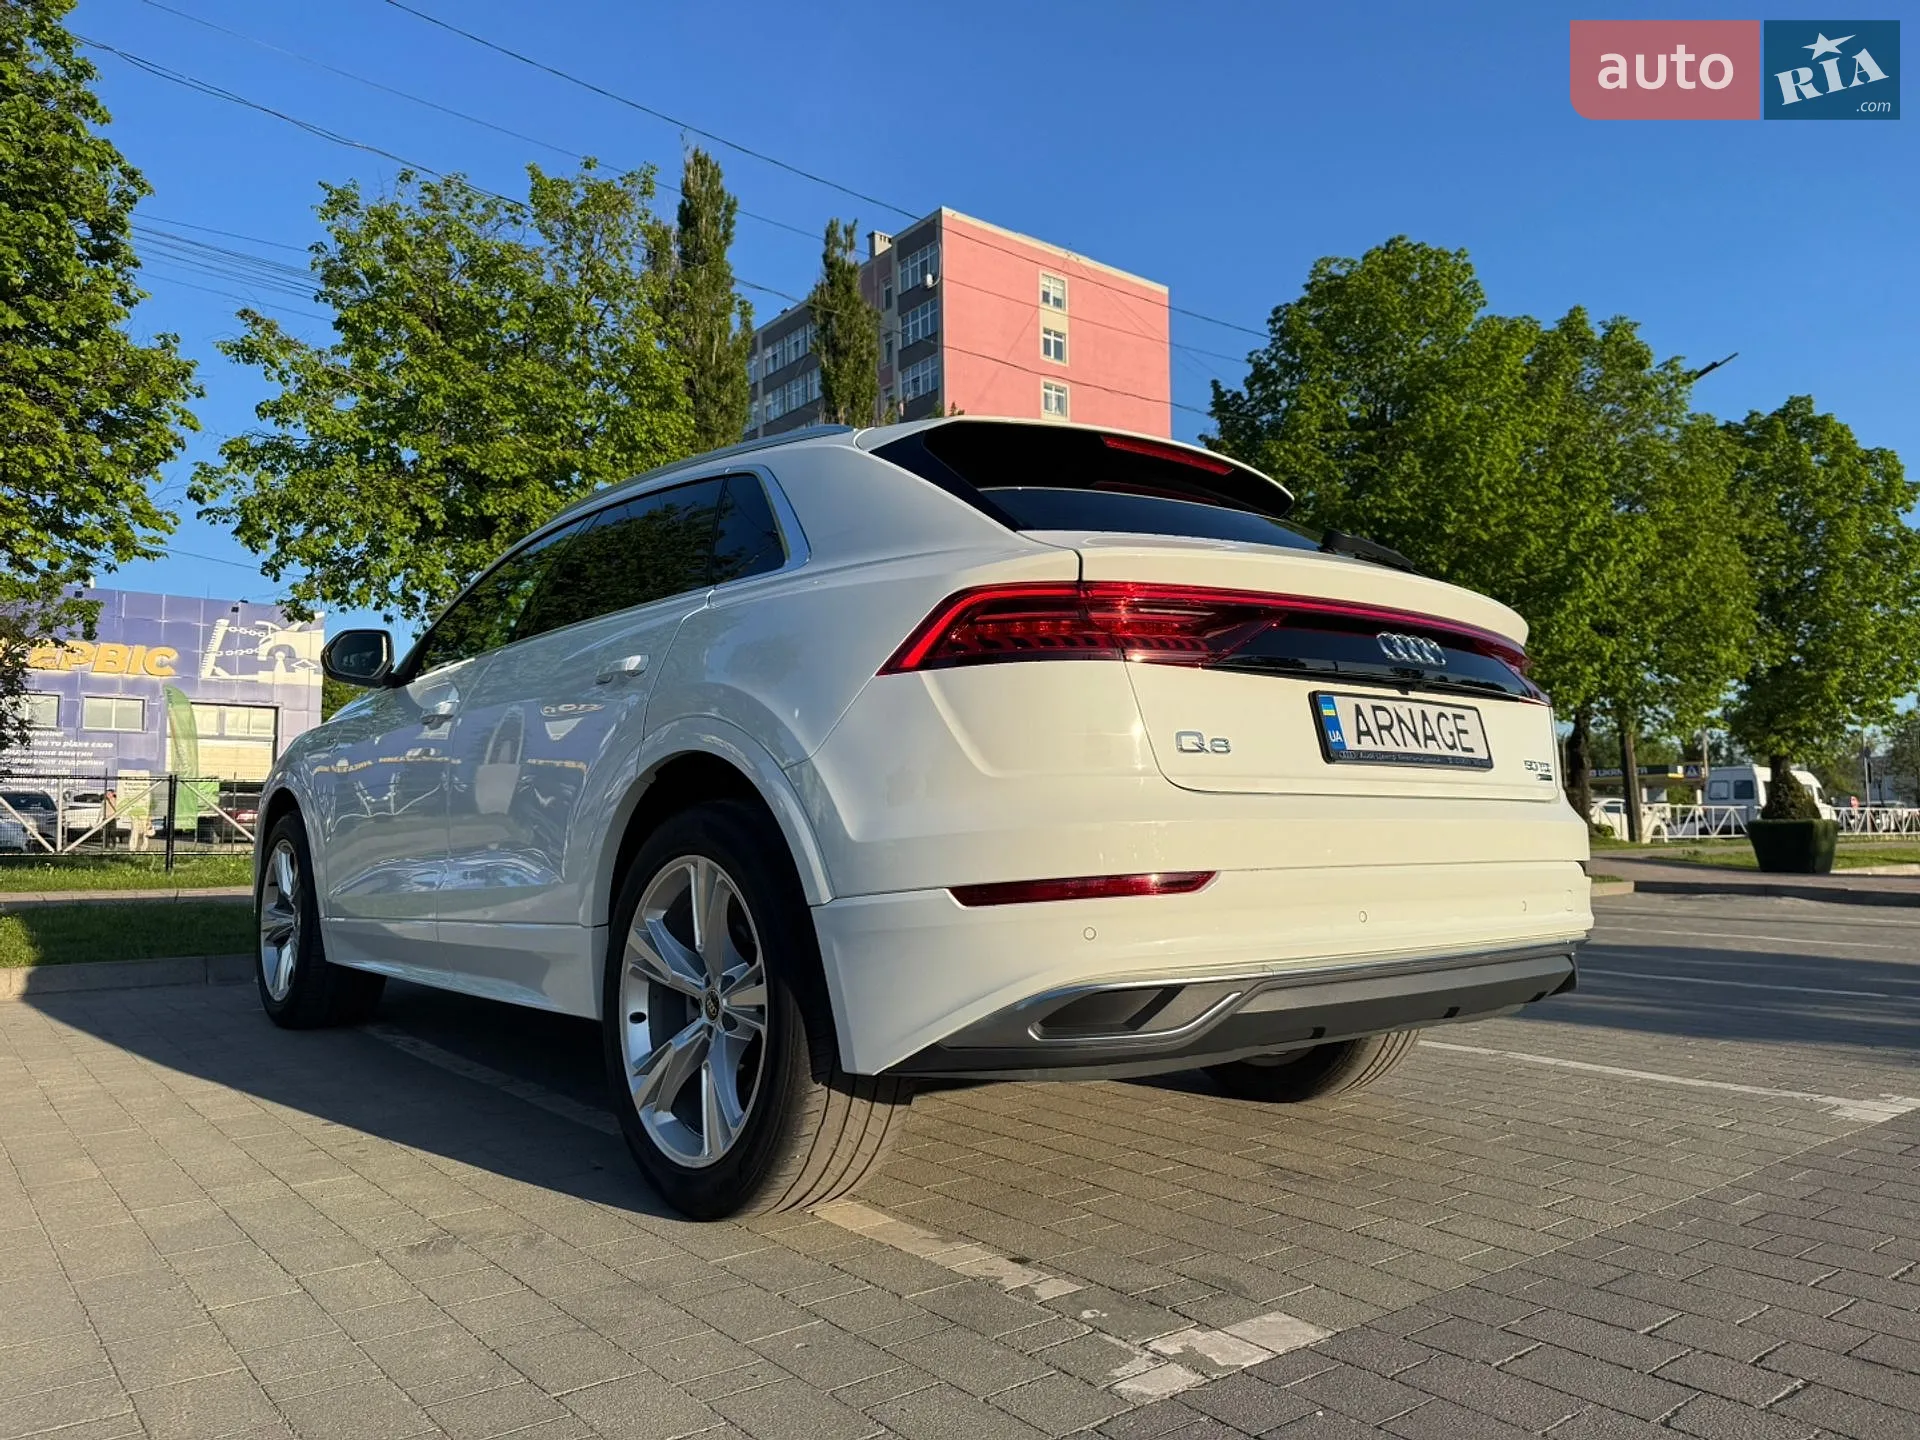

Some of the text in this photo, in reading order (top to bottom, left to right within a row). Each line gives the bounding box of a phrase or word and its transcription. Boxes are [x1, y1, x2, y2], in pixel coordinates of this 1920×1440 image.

[1, 637, 179, 676] ЕРВІС
[1175, 731, 1231, 753] Q8
[1328, 730, 1344, 744] UA
[1355, 703, 1475, 753] ARNAGE
